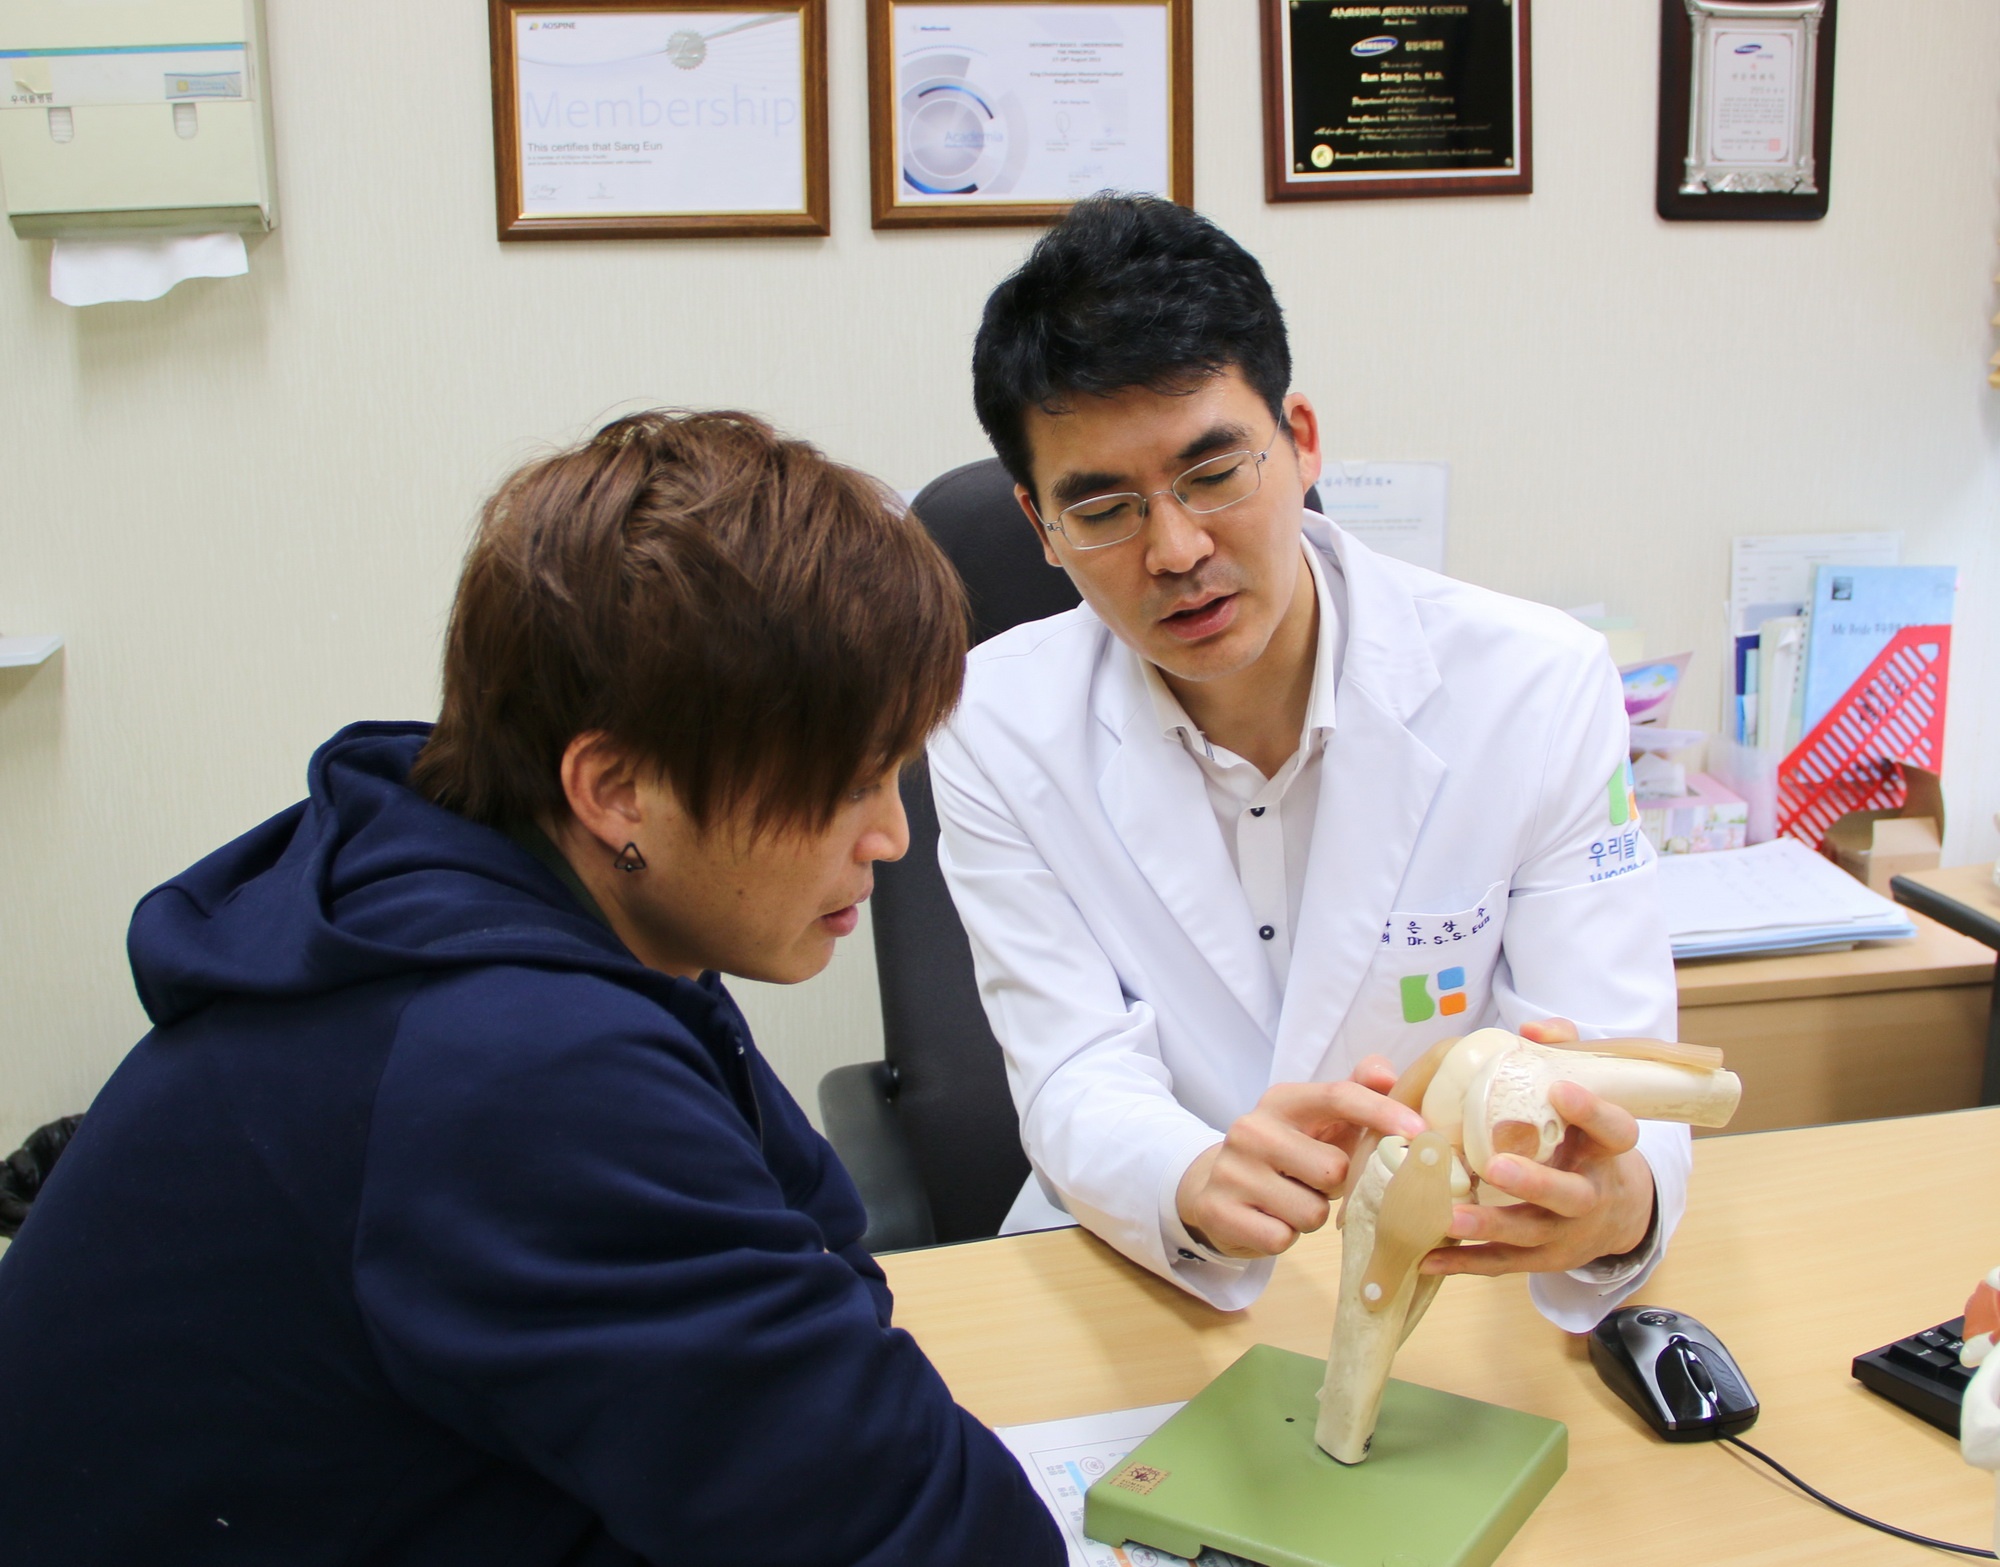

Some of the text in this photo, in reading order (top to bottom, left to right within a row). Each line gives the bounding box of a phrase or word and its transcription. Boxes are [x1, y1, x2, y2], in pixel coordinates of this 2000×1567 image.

[524, 84, 797, 137] Membership
[527, 141, 663, 154] This certifies that Sang Eun
